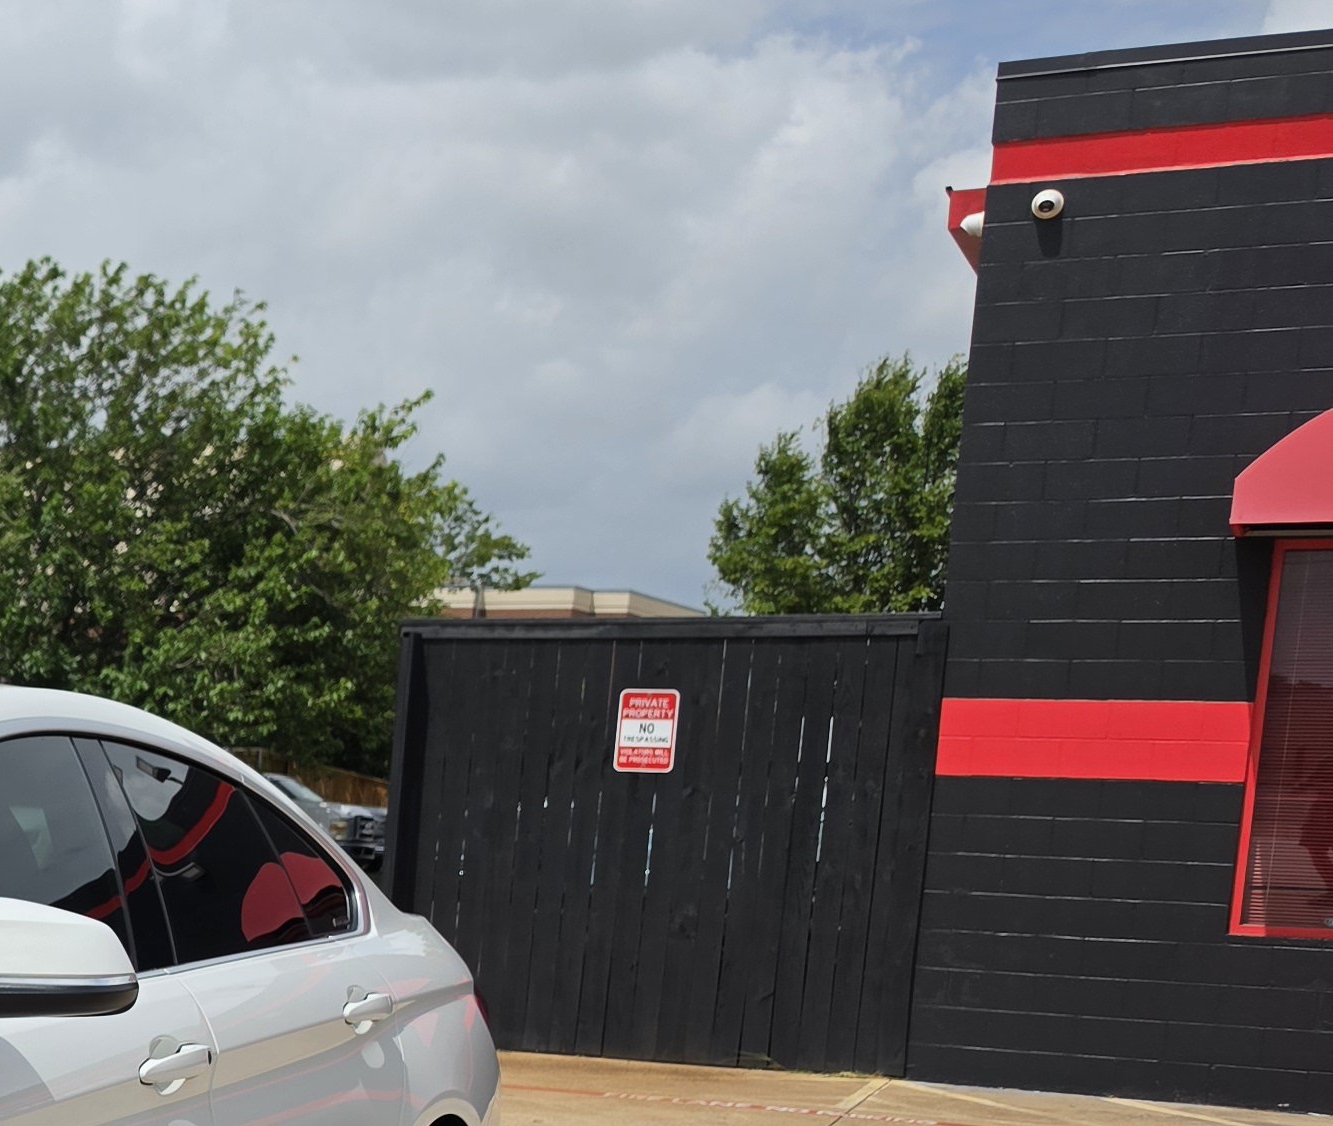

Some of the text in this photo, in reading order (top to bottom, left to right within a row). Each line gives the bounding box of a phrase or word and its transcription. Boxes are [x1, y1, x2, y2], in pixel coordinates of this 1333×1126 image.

[628, 696, 669, 709] PRIVATE
[622, 707, 674, 719] PROPERTY
[638, 722, 655, 735] NO
